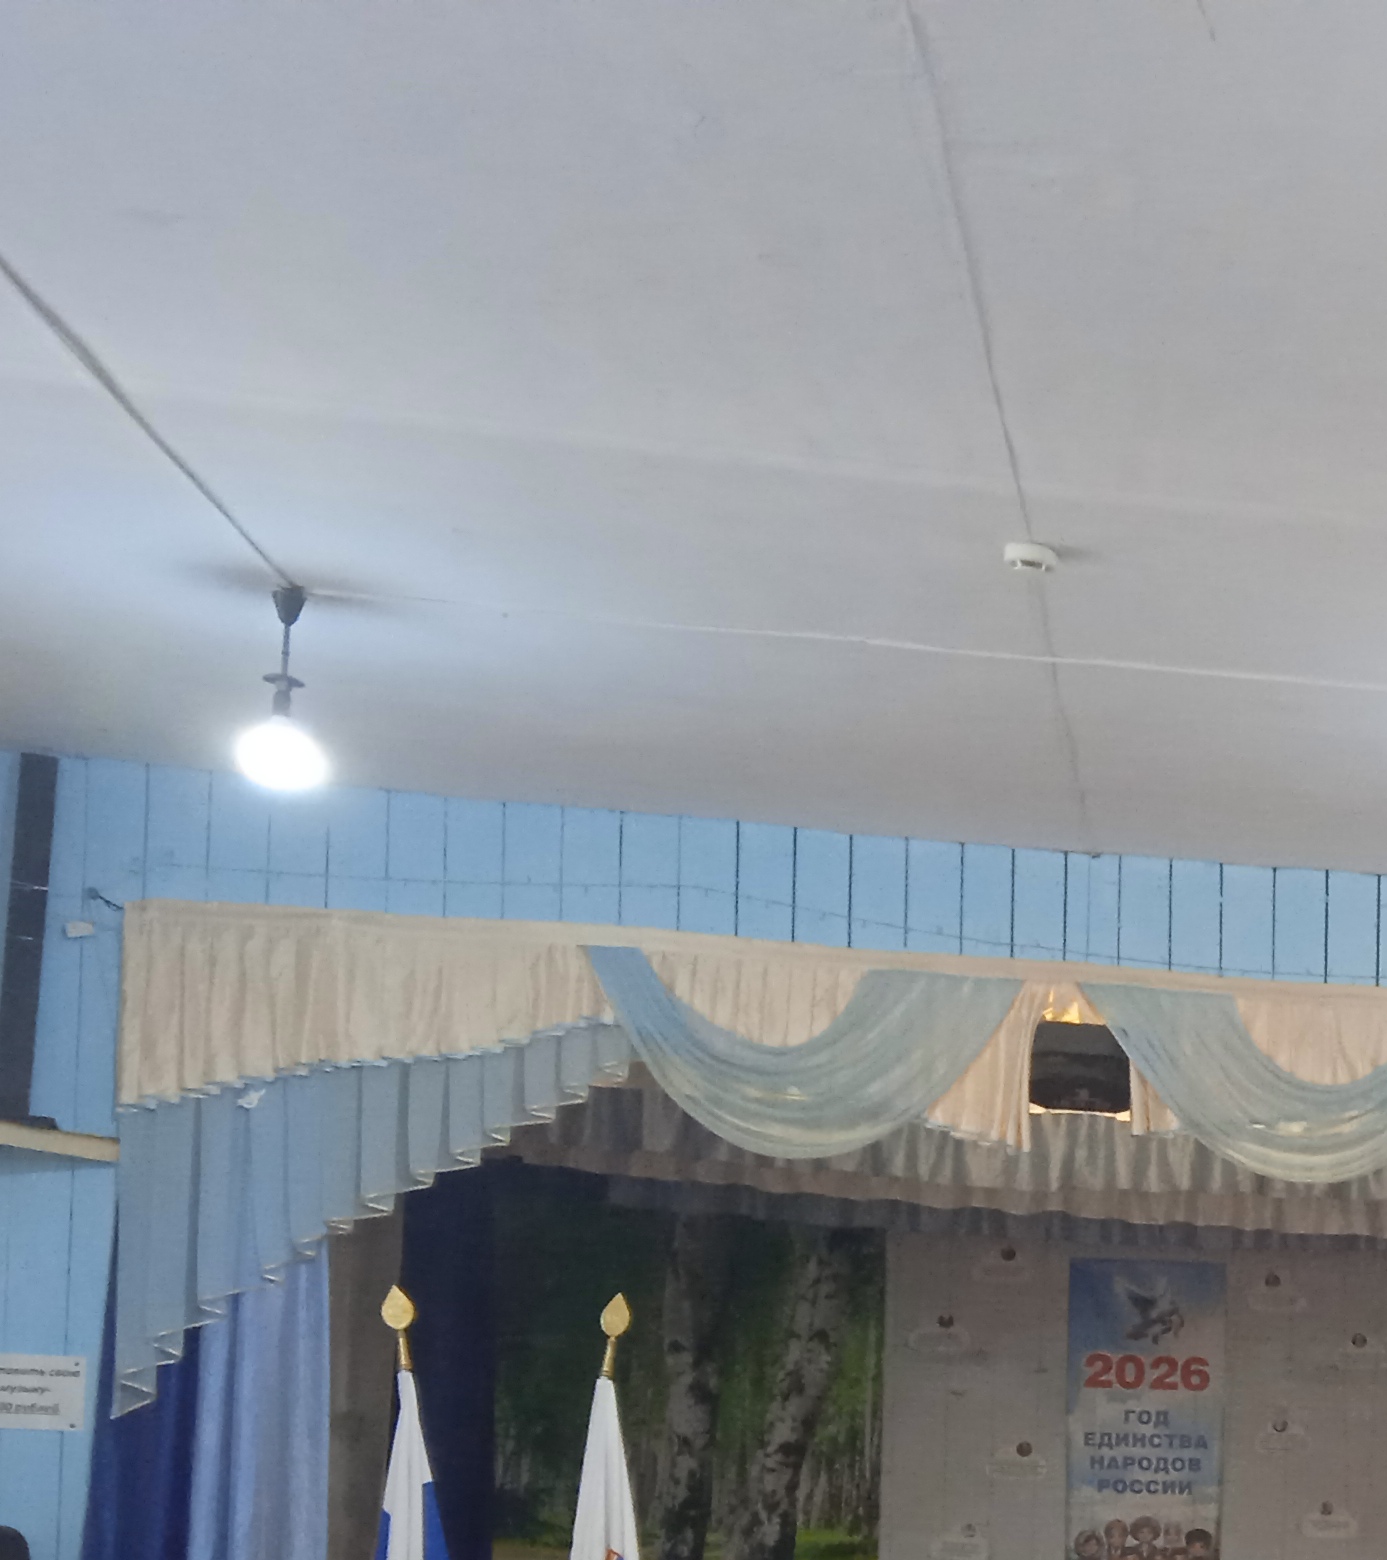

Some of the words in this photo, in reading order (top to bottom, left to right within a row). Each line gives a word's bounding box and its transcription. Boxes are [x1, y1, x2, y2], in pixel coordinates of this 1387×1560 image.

[1083, 1353, 1210, 1392] 2026
[1123, 1409, 1170, 1429] ГОД
[1083, 1431, 1209, 1450] ЕДИНСТВА
[1089, 1455, 1202, 1475] НАРОДОВ
[1097, 1479, 1193, 1496] РОССИИ
